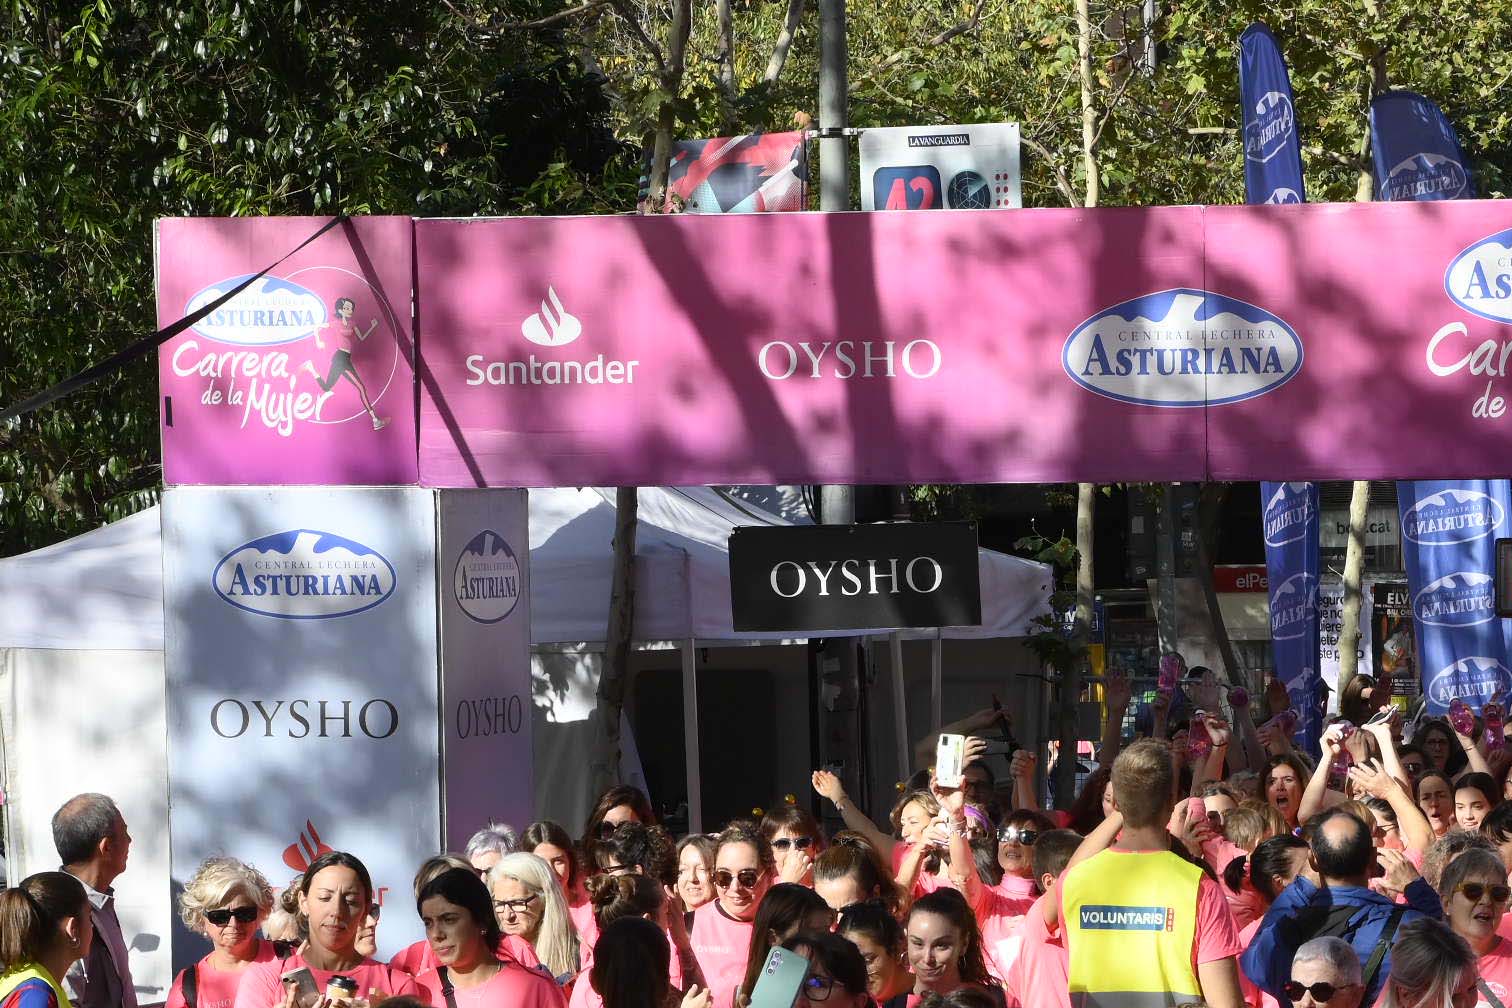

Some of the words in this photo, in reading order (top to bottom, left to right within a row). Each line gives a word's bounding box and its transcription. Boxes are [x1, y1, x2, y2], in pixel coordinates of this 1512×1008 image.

[1117, 330, 1193, 342] CENTRAL
[1199, 328, 1277, 341] LECHERA
[172, 340, 289, 378] Carrera
[465, 354, 640, 386] Santander
[757, 338, 942, 380] OYSHO
[1080, 333, 1285, 377] ASTURIANA
[201, 378, 223, 406] de
[228, 378, 244, 406] la
[240, 376, 334, 437] Mujer
[1472, 379, 1508, 420] de
[227, 562, 383, 596] ASTURIANA
[254, 560, 313, 569] CENTRAL
[459, 565, 517, 600] ASTURIANA
[769, 556, 943, 598] OYSHO
[1235, 573, 1268, 589] elPe
[210, 698, 399, 739] OYSHO
[456, 694, 522, 740] OYSHO
[1081, 911, 1164, 925] VOLUNTARIS
